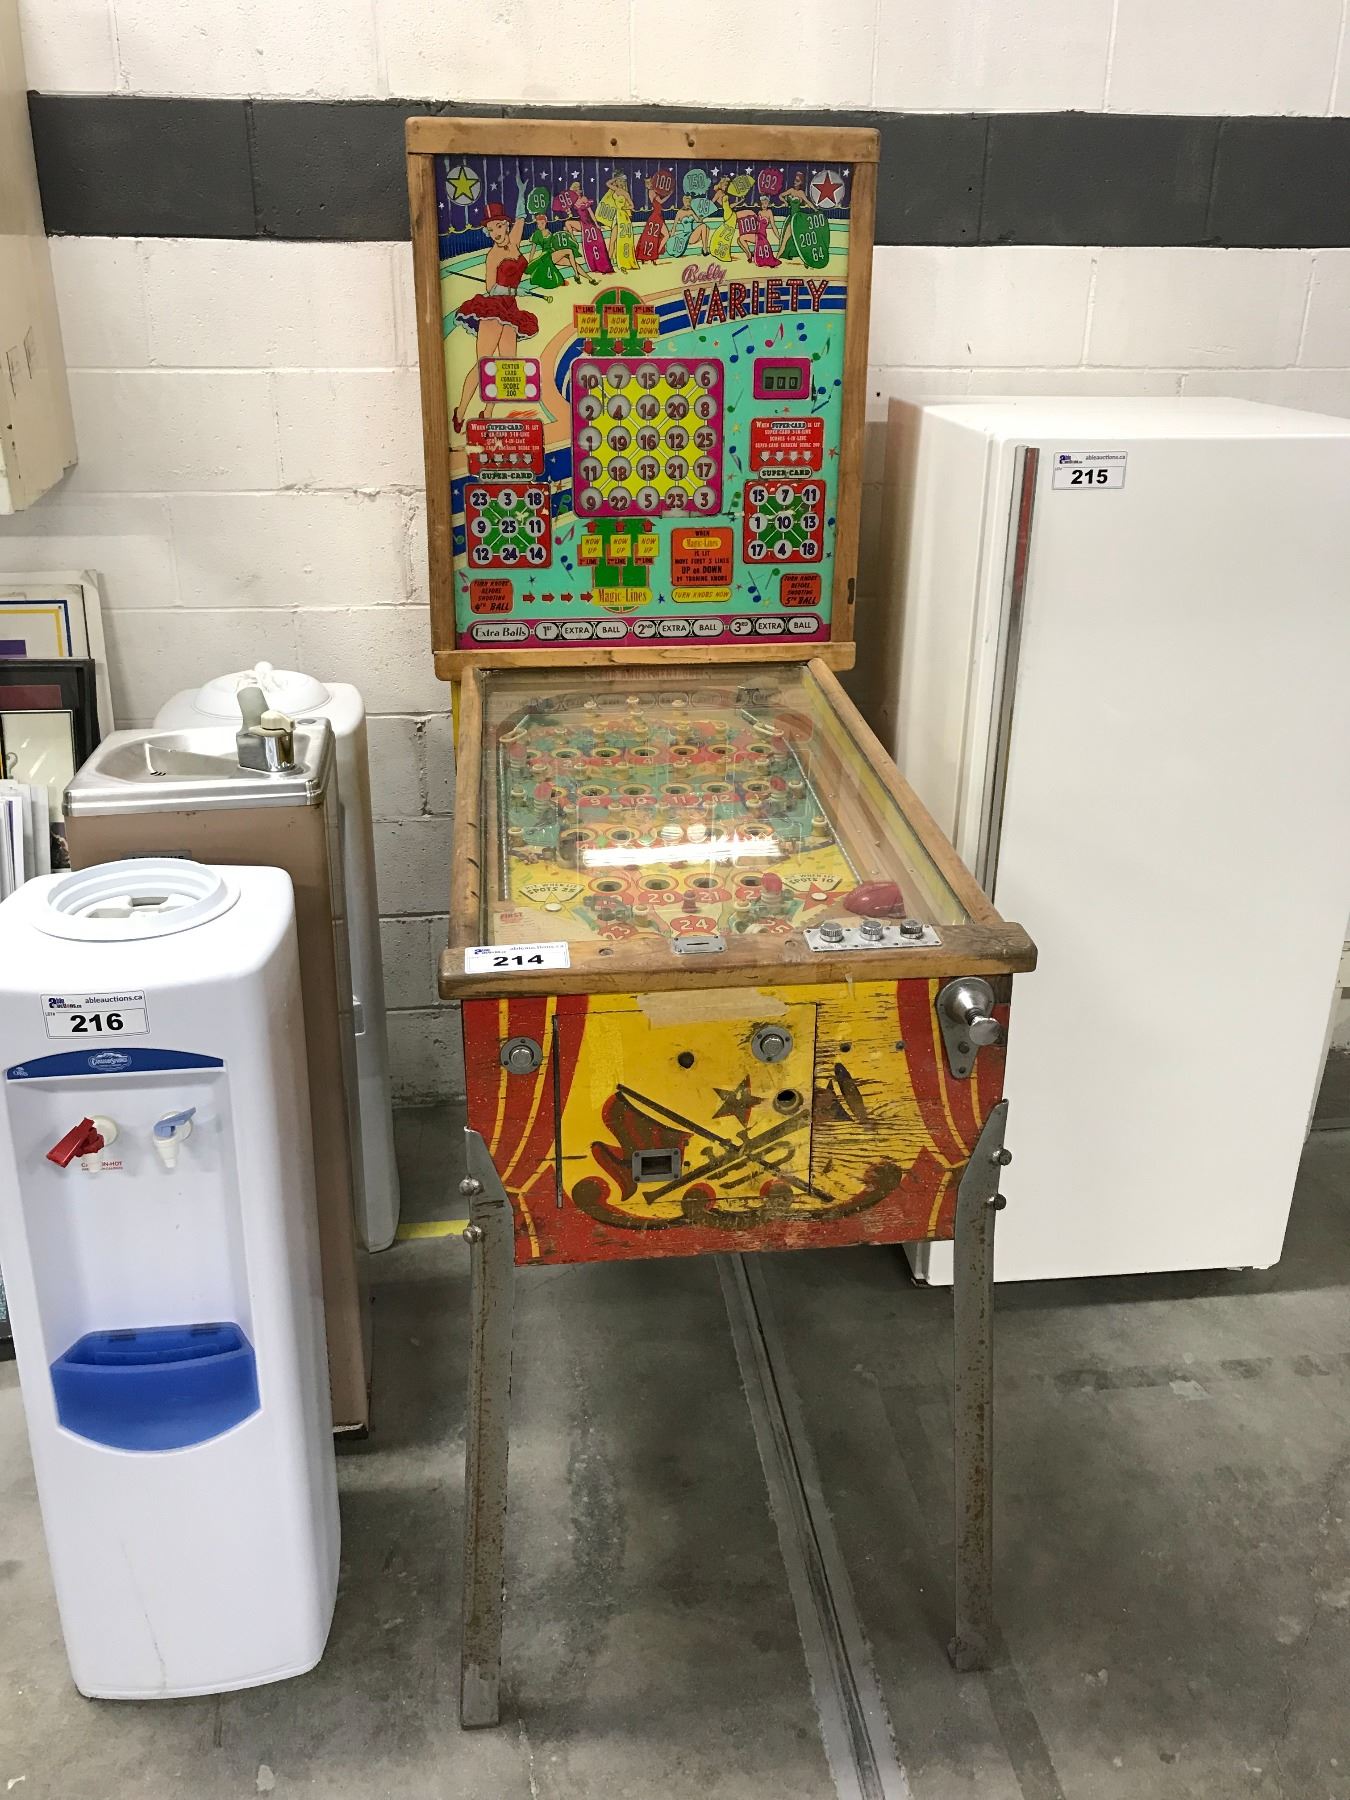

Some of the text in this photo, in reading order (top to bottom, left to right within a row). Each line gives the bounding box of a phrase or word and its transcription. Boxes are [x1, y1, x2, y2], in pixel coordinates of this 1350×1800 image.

[655, 174, 672, 191] 100
[761, 174, 777, 190] 192
[534, 194, 546, 208] 96
[559, 192, 572, 208] 96
[740, 217, 757, 233] 100
[807, 213, 825, 230] 300
[585, 227, 598, 242] 20
[647, 222, 660, 237] 32
[558, 233, 568, 247] 16
[799, 231, 817, 248] 200
[593, 246, 600, 260] 6
[643, 242, 654, 256] 12
[758, 244, 770, 258] 48
[812, 246, 824, 262] 64
[547, 267, 552, 279] 4
[682, 263, 727, 285] Bally
[683, 279, 829, 330] VARIETY
[581, 374, 598, 389] 10
[615, 374, 623, 387] 7
[641, 372, 656, 388] 15
[669, 372, 685, 388] 24
[701, 371, 710, 387] 6
[585, 405, 594, 420] 2
[613, 404, 623, 419] 4
[640, 403, 656, 418] 14
[668, 402, 687, 418] 20
[701, 402, 709, 417] 8
[586, 435, 593, 450] 1
[610, 435, 627, 450] 19
[641, 434, 656, 450] 16
[669, 433, 684, 449] 12
[697, 433, 713, 448] 25
[481, 472, 533, 480] SUPER-CARD
[583, 465, 597, 480] 11
[611, 465, 627, 481] 18
[641, 463, 656, 479] 13
[669, 463, 684, 479] 21
[697, 462, 713, 478] 17
[762, 469, 811, 477] SUPER-CARD
[1071, 469, 1108, 484] 215
[473, 493, 488, 507] 23
[504, 493, 512, 506] 3
[528, 493, 542, 506] 18
[644, 493, 653, 509] 5
[668, 493, 684, 509] 23
[700, 492, 709, 508] 3
[752, 489, 765, 502] 15
[782, 489, 789, 502] 7
[803, 488, 817, 502] 11
[586, 495, 596, 511] 9
[611, 495, 628, 511] 22
[477, 520, 486, 534] 9
[501, 520, 517, 534] 25
[529, 519, 542, 533] 11
[755, 516, 760, 530] 1
[776, 516, 792, 529] 10
[803, 516, 816, 529] 13
[475, 547, 490, 561] 12
[502, 547, 518, 560] 24
[529, 547, 544, 560] 14
[751, 544, 764, 557] 17
[777, 543, 787, 556] 4
[801, 542, 815, 555] 18
[681, 566, 690, 574] UP
[598, 588, 647, 604] Magic-Lines
[798, 597, 816, 605] BALL
[475, 625, 527, 637] Extra Balls
[565, 626, 590, 634] EXTRA
[602, 625, 620, 633] BALL
[637, 623, 718, 634] 2ND EXTRA BALL
[734, 620, 812, 632] 3RD EXTRA BALL
[590, 797, 600, 806] 9
[630, 797, 648, 805] 10
[527, 886, 559, 895] SPOTS
[700, 892, 719, 901] 21
[648, 893, 675, 903] 20
[679, 919, 709, 930] 24
[493, 955, 544, 966] 214
[85, 995, 143, 1004] ableauctions.ca
[70, 1013, 124, 1033] 216
